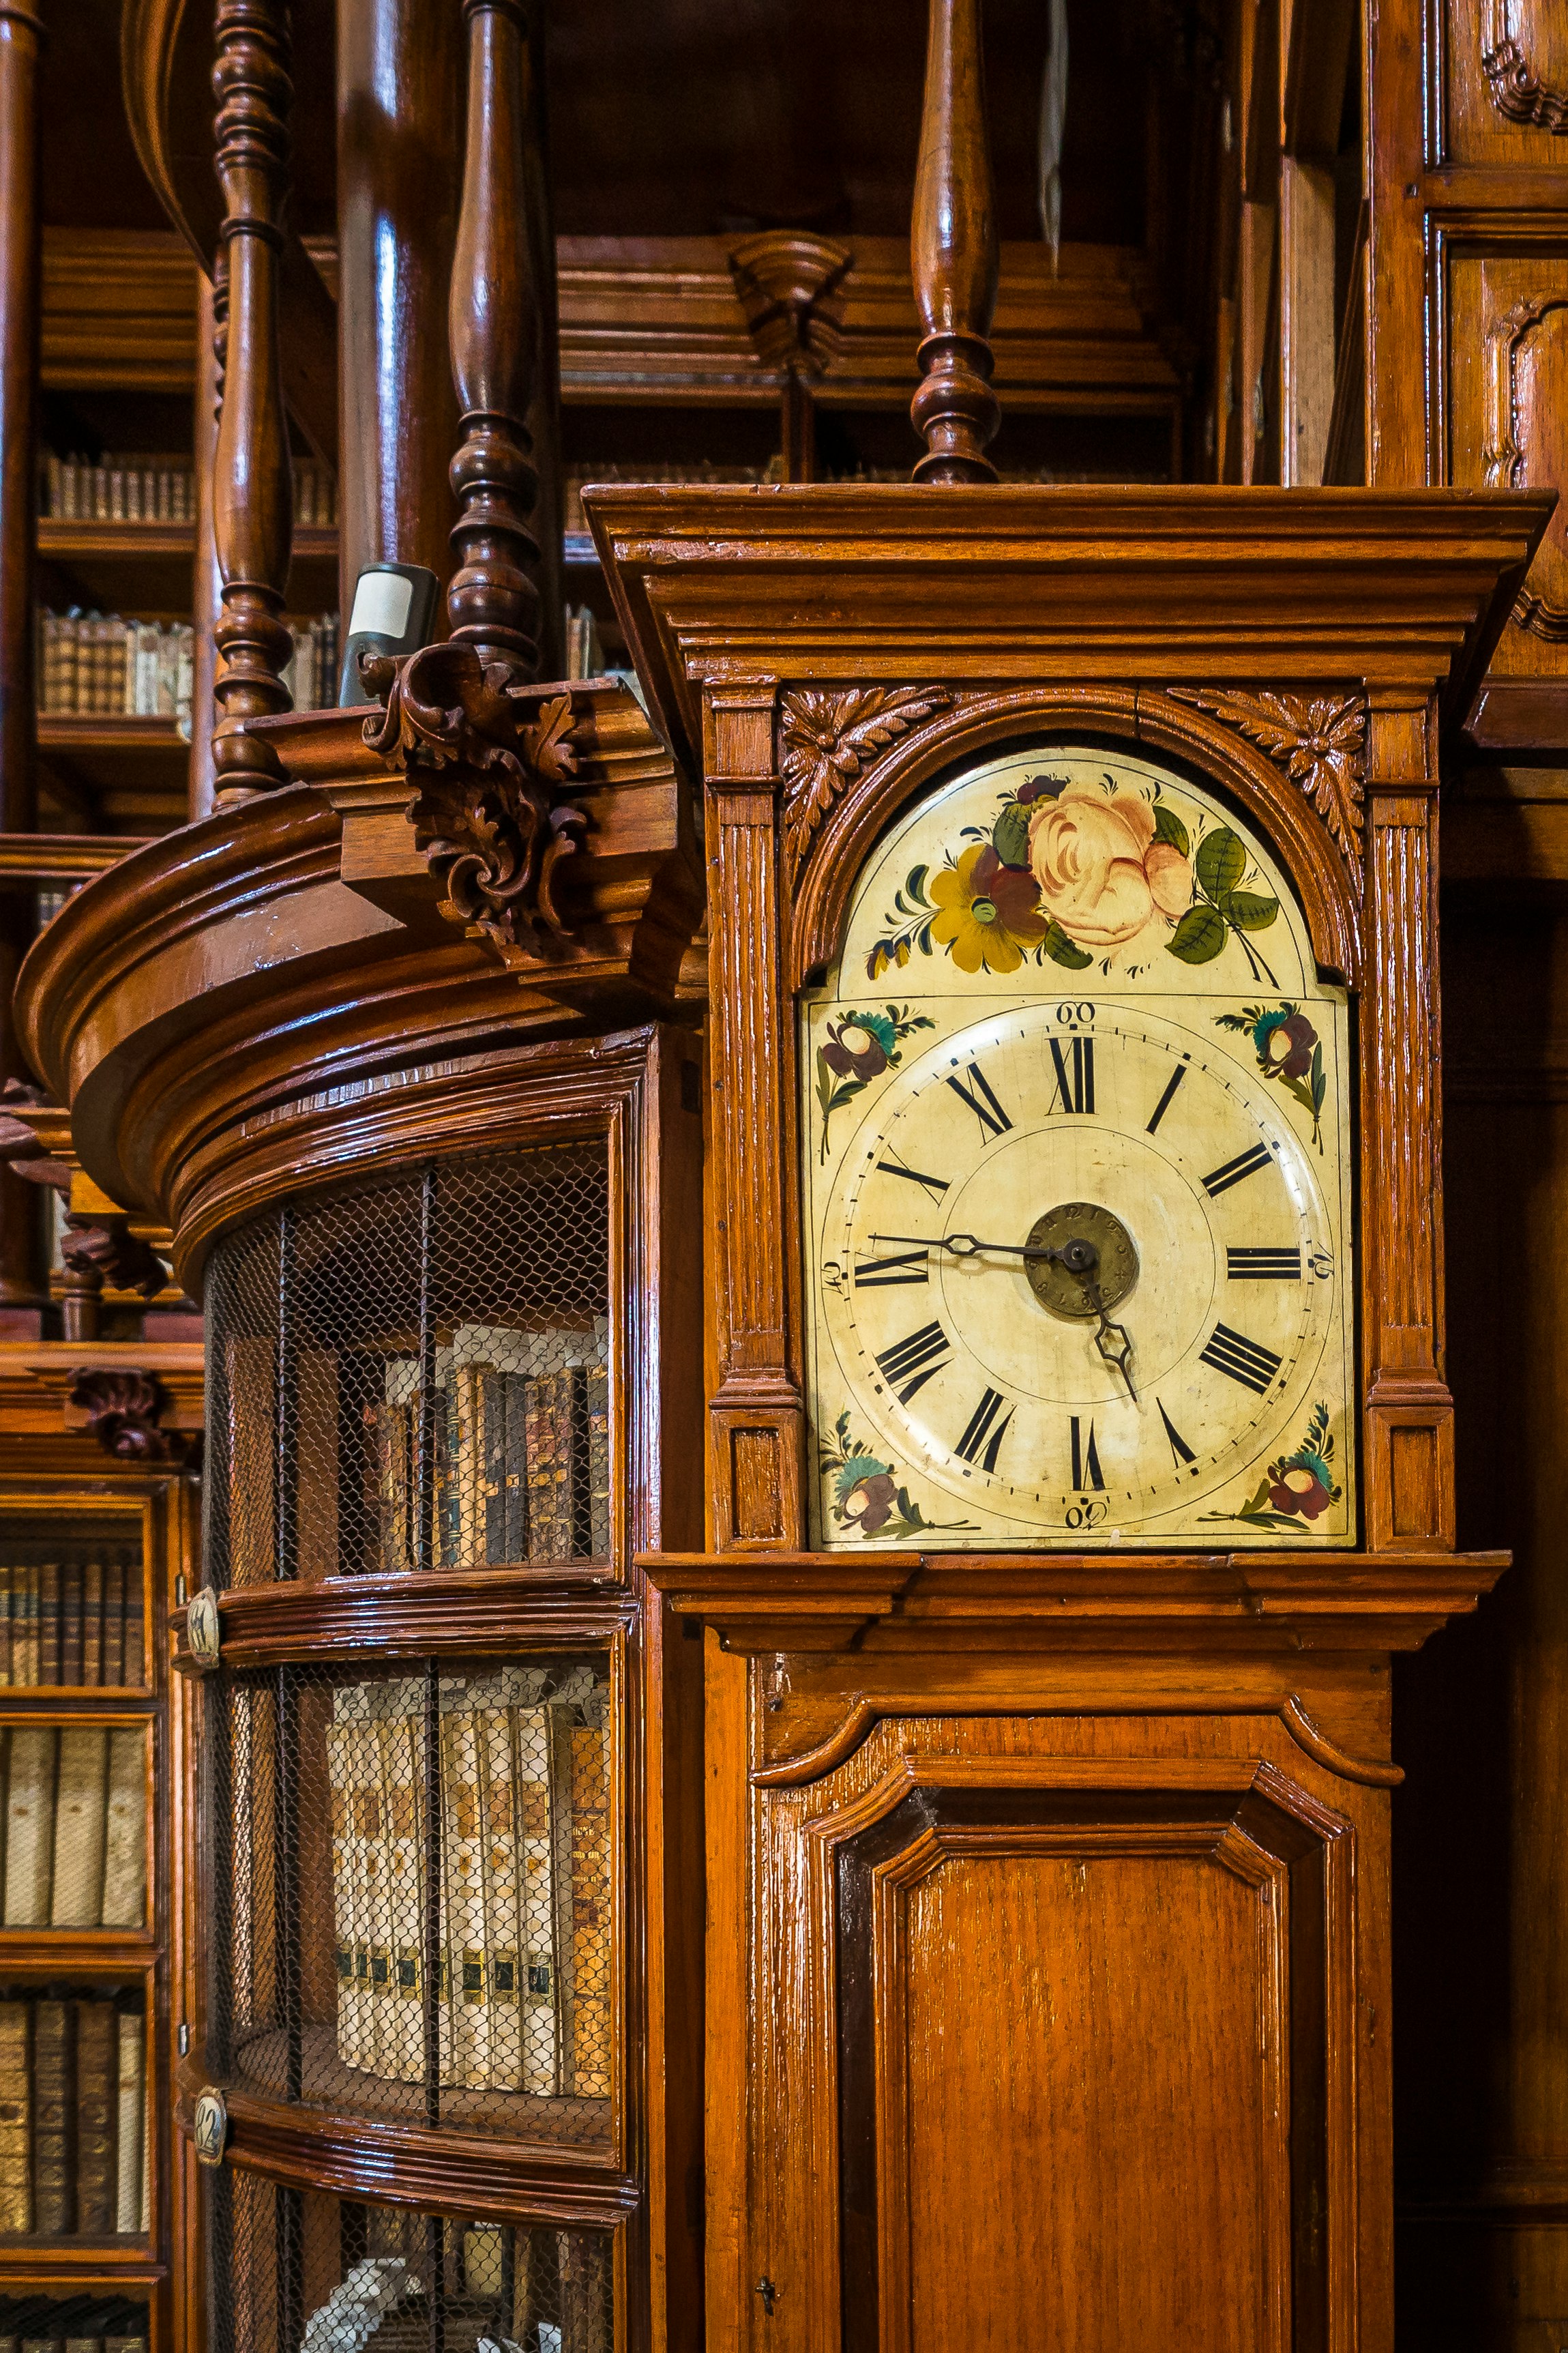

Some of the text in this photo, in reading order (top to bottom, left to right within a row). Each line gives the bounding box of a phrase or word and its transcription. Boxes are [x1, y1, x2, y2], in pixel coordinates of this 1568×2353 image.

[1056, 1002, 1095, 1023] 60
[941, 1058, 1017, 1148] XI
[1044, 1036, 1099, 1116] XII
[1144, 1063, 1187, 1137] I
[874, 1141, 953, 1209] X
[1198, 1138, 1275, 1199] II
[820, 1261, 844, 1295] 45
[854, 1248, 930, 1289] IX
[1226, 1242, 1301, 1286] III
[1313, 1241, 1335, 1279] 15
[872, 1318, 955, 1410] VIII
[1198, 1319, 1284, 1398] IIII
[951, 1384, 1018, 1476] VII
[1067, 1416, 1113, 1491] VI
[1155, 1397, 1202, 1470] V
